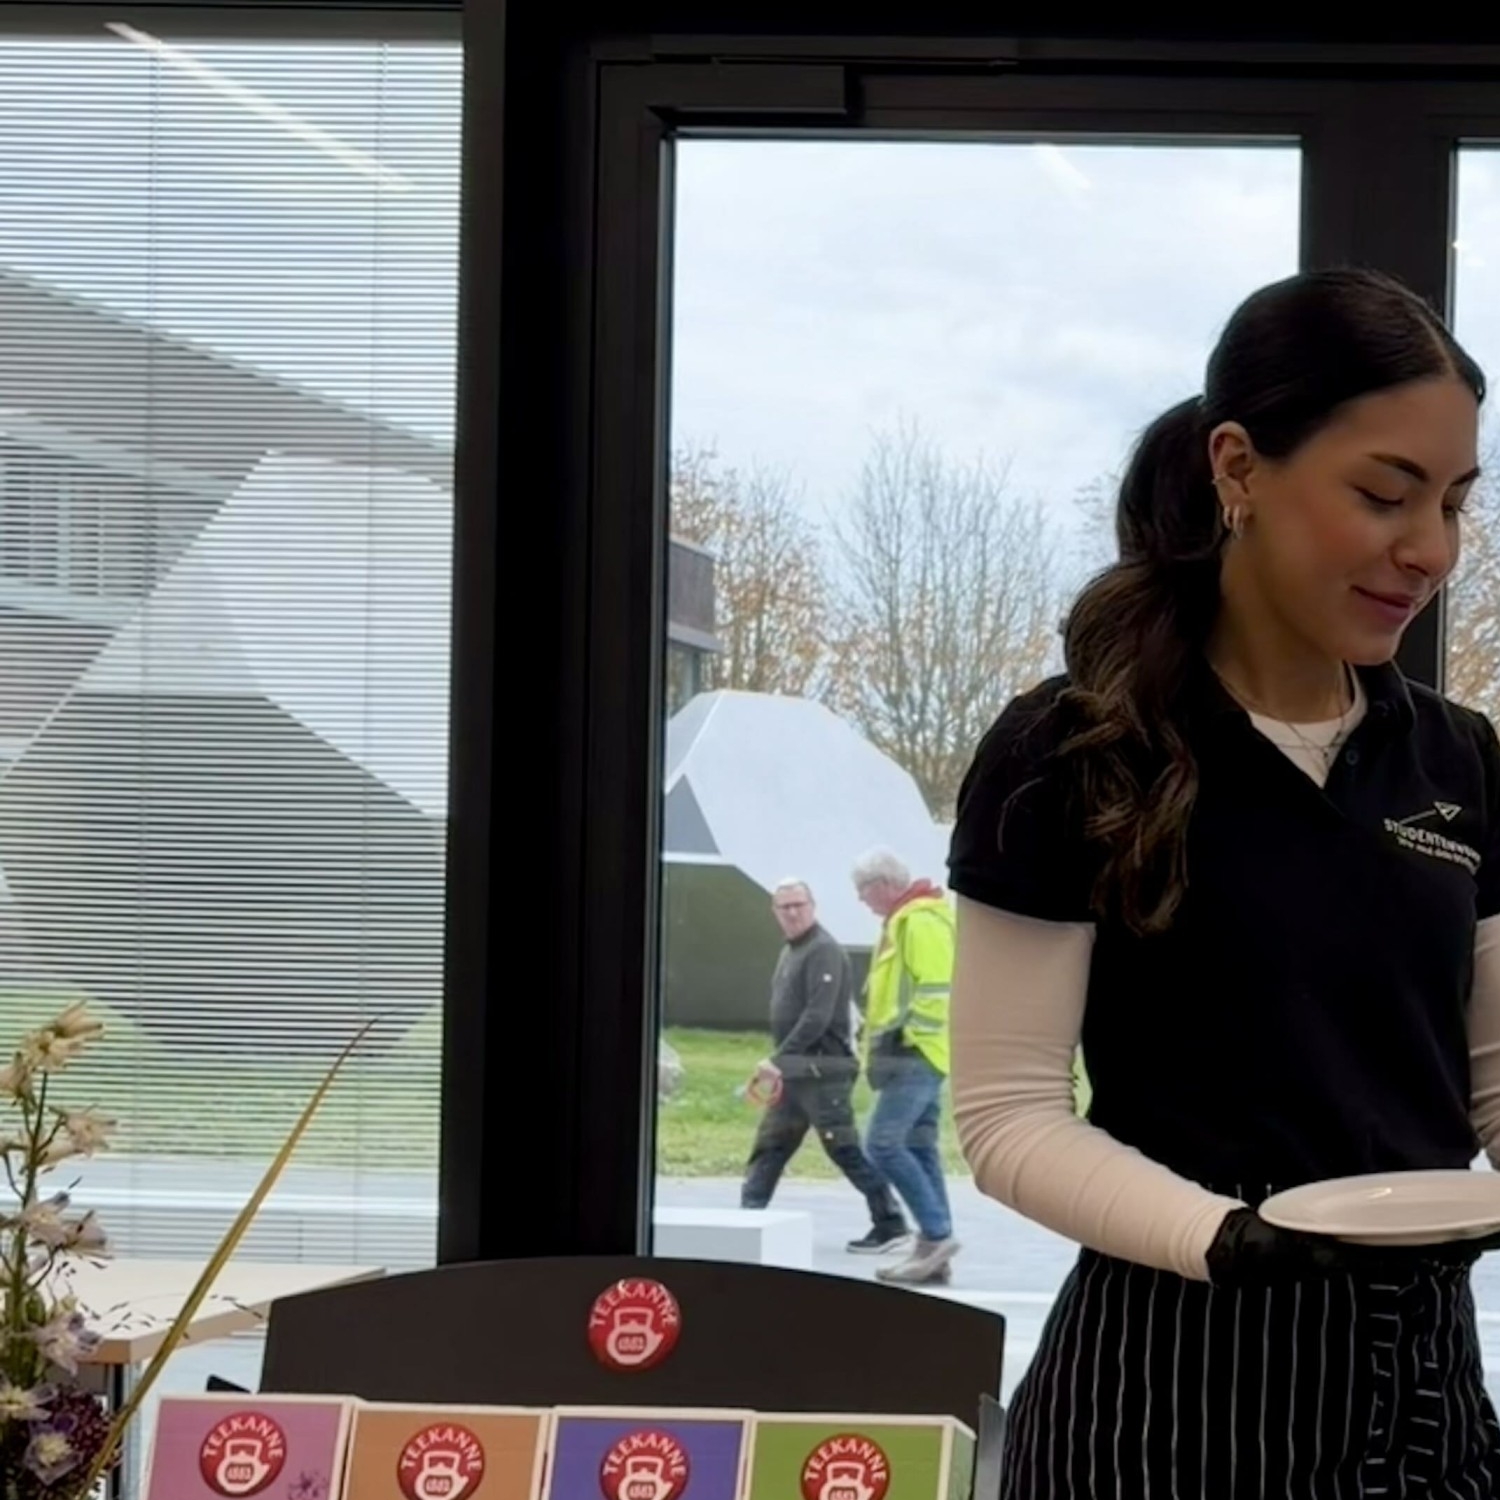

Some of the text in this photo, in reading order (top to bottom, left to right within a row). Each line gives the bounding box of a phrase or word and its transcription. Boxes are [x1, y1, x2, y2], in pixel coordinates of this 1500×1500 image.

[588, 1280, 678, 1328] TEEKANNE
[202, 1415, 284, 1459] TEEKANNE
[401, 1427, 482, 1471] TEEKANNE
[602, 1433, 686, 1477] TEEKANNE
[804, 1438, 887, 1482] TEEKANNE
